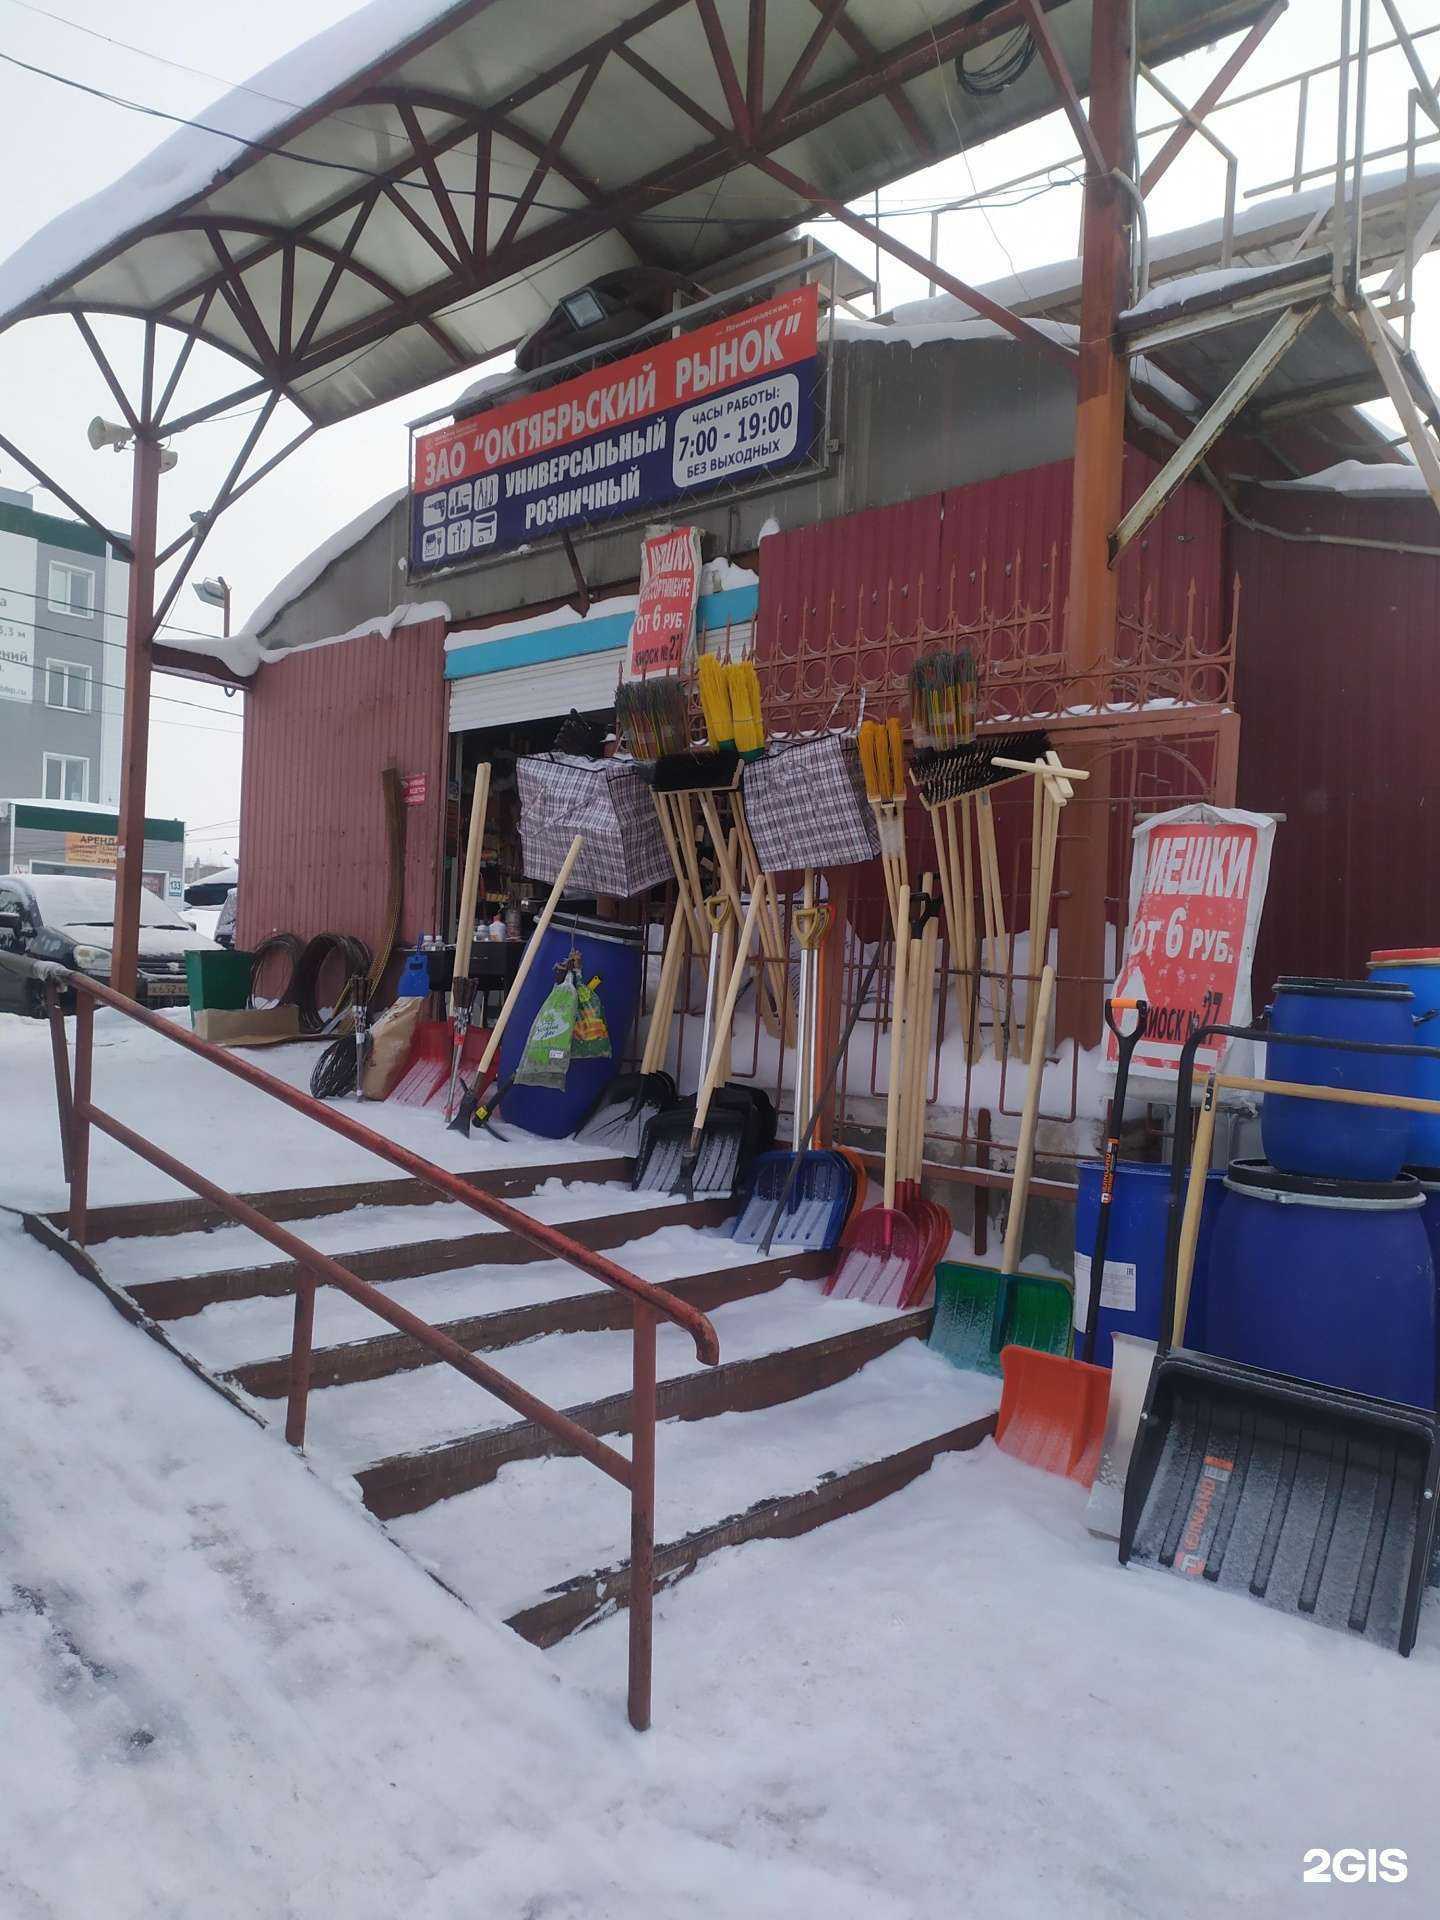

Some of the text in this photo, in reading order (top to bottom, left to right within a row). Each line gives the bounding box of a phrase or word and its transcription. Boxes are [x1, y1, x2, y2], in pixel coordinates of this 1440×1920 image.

[424, 312, 801, 486] ЗАО "ОКТЯБРЬСКИЙ РЫНОК"
[692, 386, 780, 425] ЧАСЫ РАБОТЫ:
[505, 416, 667, 498] УНИВЕРСАЛЬНЫЙ
[679, 426, 717, 462] 7:00
[737, 402, 792, 443] 19:00
[687, 438, 780, 478] БЕЗ ВЫХОДНЫХ
[525, 464, 640, 529] РОЗНИЧНЫЙ
[637, 604, 684, 635] ОТ 6 РУБ.
[80, 835, 118, 847] АРЕНД
[1130, 907, 1233, 963] ОТ 6 РУБ.
